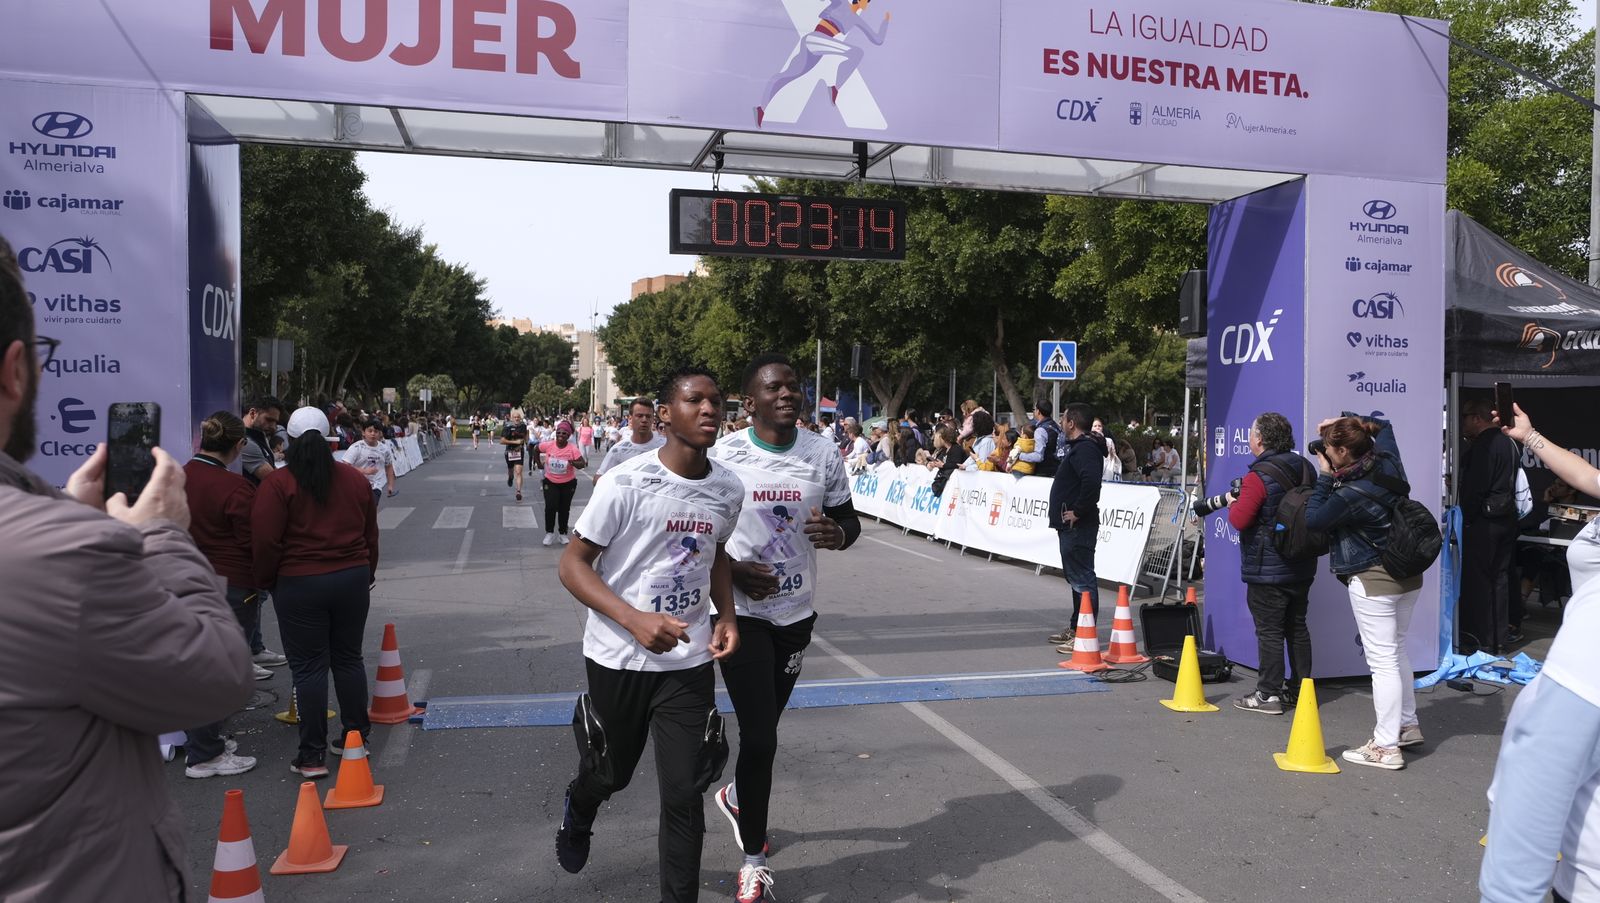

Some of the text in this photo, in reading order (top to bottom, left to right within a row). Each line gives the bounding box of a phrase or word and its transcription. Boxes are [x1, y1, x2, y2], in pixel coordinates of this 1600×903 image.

[209, 0, 582, 79] MUJER
[1090, 9, 1268, 52] LA IGUALDAD
[1043, 48, 1309, 99] ES NUESTRA META.
[1056, 98, 1103, 122] CDX
[1152, 105, 1201, 120] ALMERÍA
[1151, 117, 1178, 127] CIUDAD
[9, 141, 117, 159] HYUNDAI
[23, 159, 105, 174] Almerialva
[37, 193, 124, 213] cajamar
[711, 198, 895, 251] 00:23:14
[1349, 221, 1409, 235] HYUNDAI
[1357, 234, 1403, 246] Almerialva
[18, 246, 92, 274] CASI
[1364, 259, 1412, 273] cajamar
[44, 294, 121, 313] vithas
[202, 283, 236, 341] CDX
[1352, 299, 1394, 320] CASI
[44, 315, 122, 325] vivir para cuidarte
[1219, 309, 1284, 365] CDX
[1365, 334, 1409, 348] vithas
[46, 355, 121, 377] qualia
[1356, 379, 1407, 396] aqualia
[753, 490, 802, 502] MUJER
[1010, 496, 1050, 518] ALMER
[666, 519, 713, 535] MUJER
[1100, 506, 1144, 531] MERÍA
[651, 588, 701, 613] 1353
